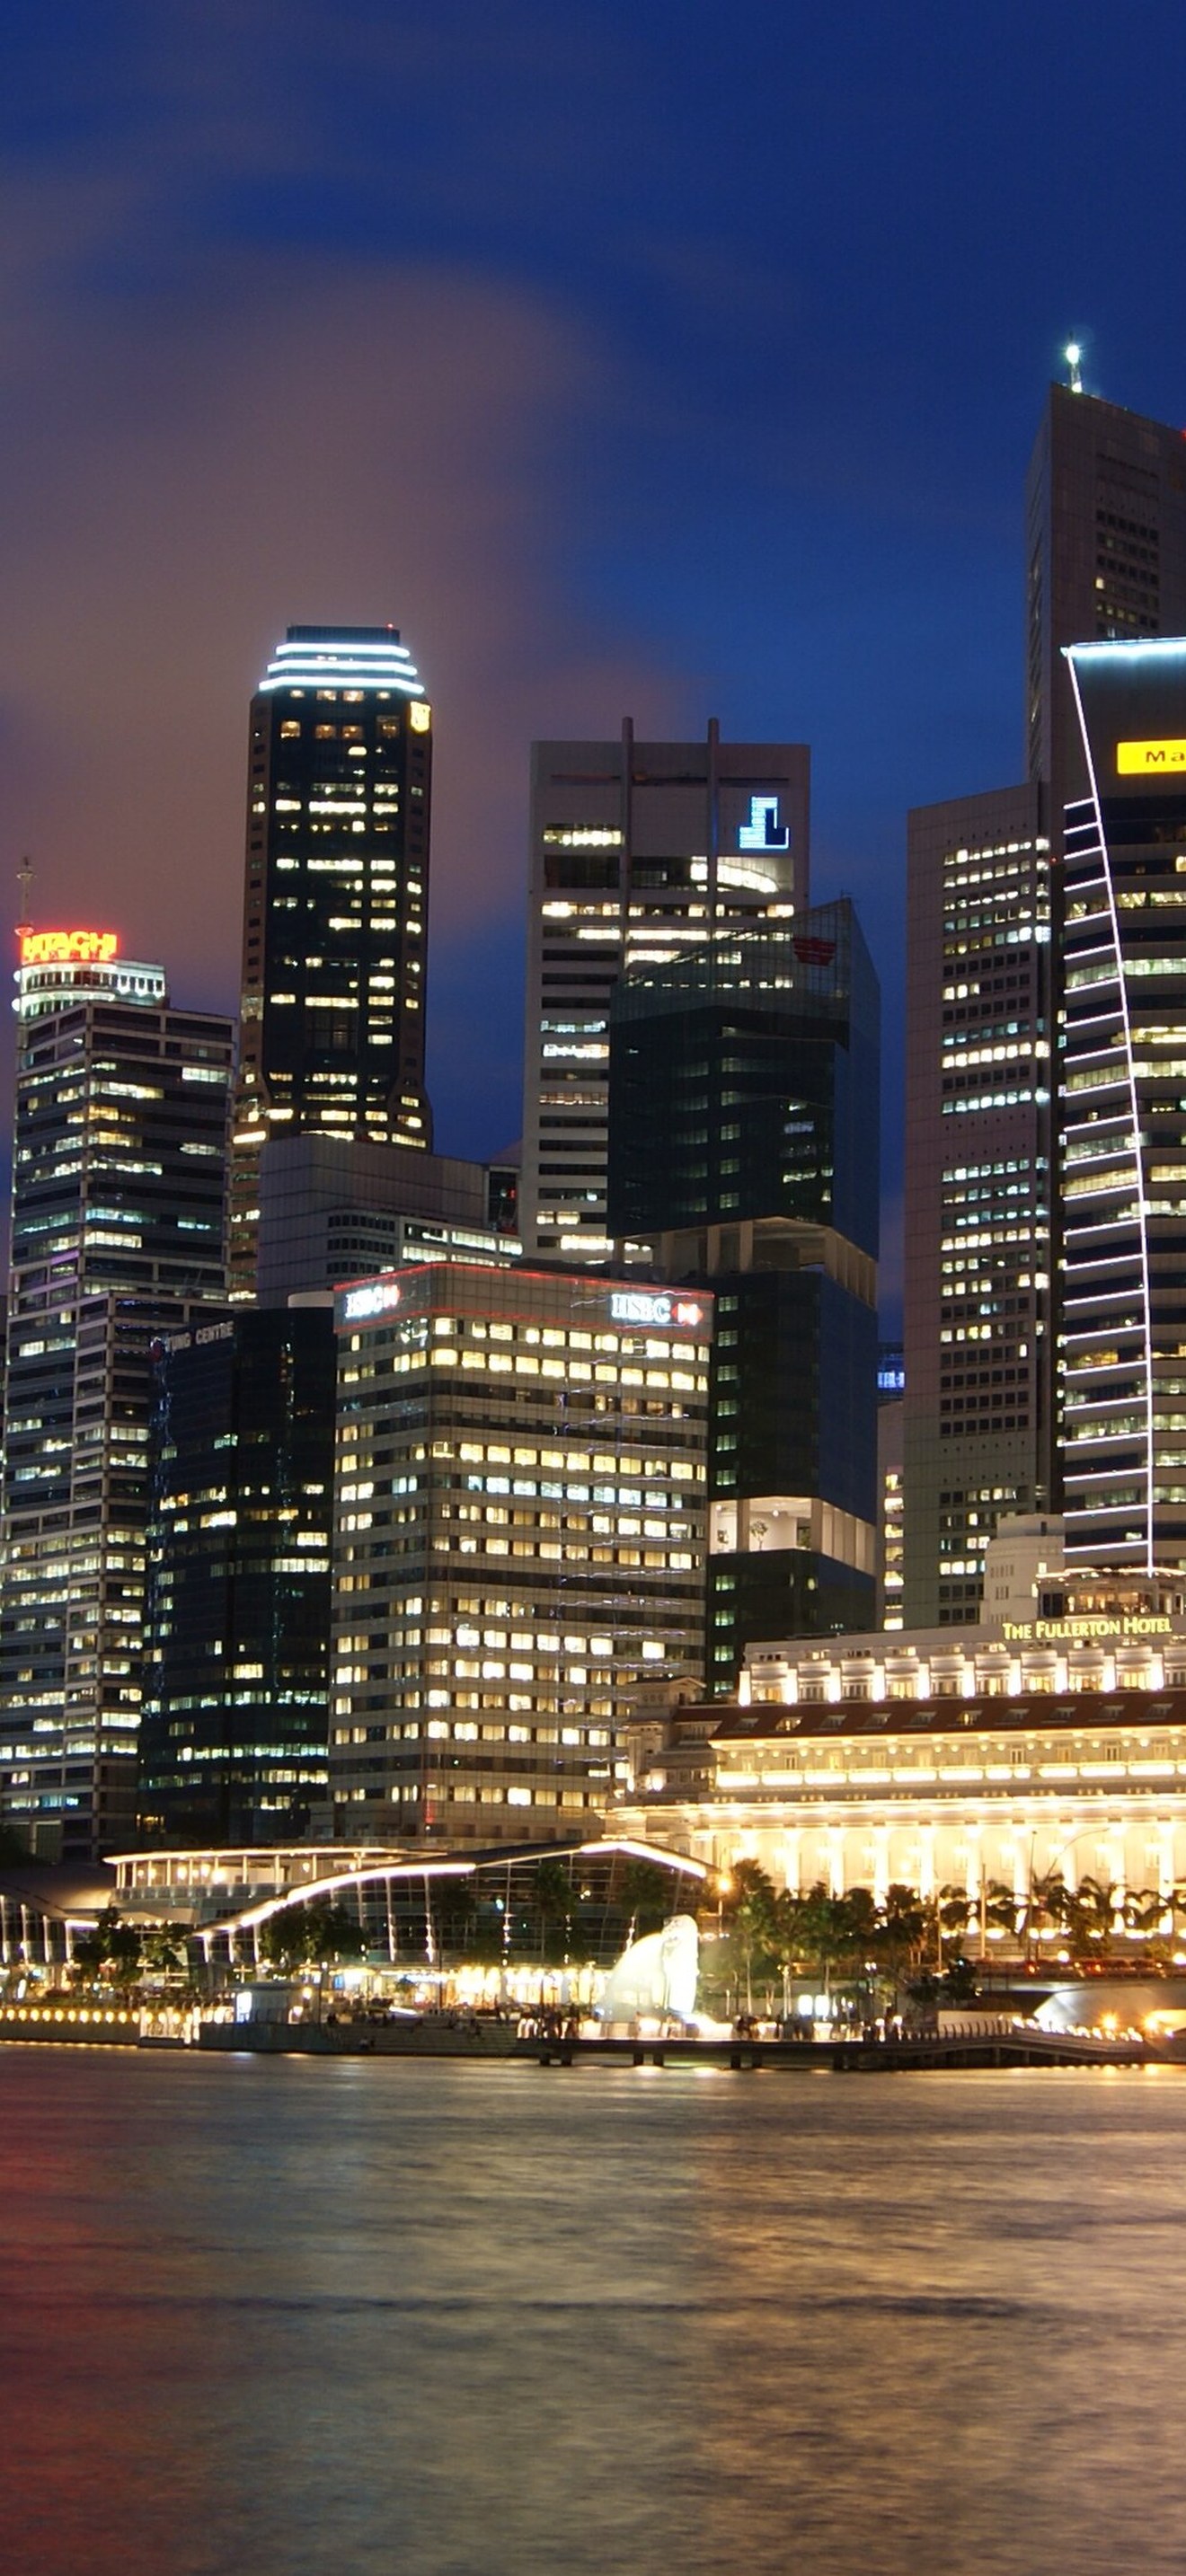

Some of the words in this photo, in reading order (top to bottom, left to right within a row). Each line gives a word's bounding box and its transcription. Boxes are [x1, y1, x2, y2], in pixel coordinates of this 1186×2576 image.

[1146, 750, 1186, 763] Ma
[22, 931, 117, 957] HITACHI
[611, 1293, 671, 1323] HSBC
[195, 1320, 235, 1345] CENTRE
[1002, 1622, 1032, 1640] THE
[1035, 1619, 1121, 1639] FULLERTON
[1123, 1616, 1173, 1634] HOTEL
